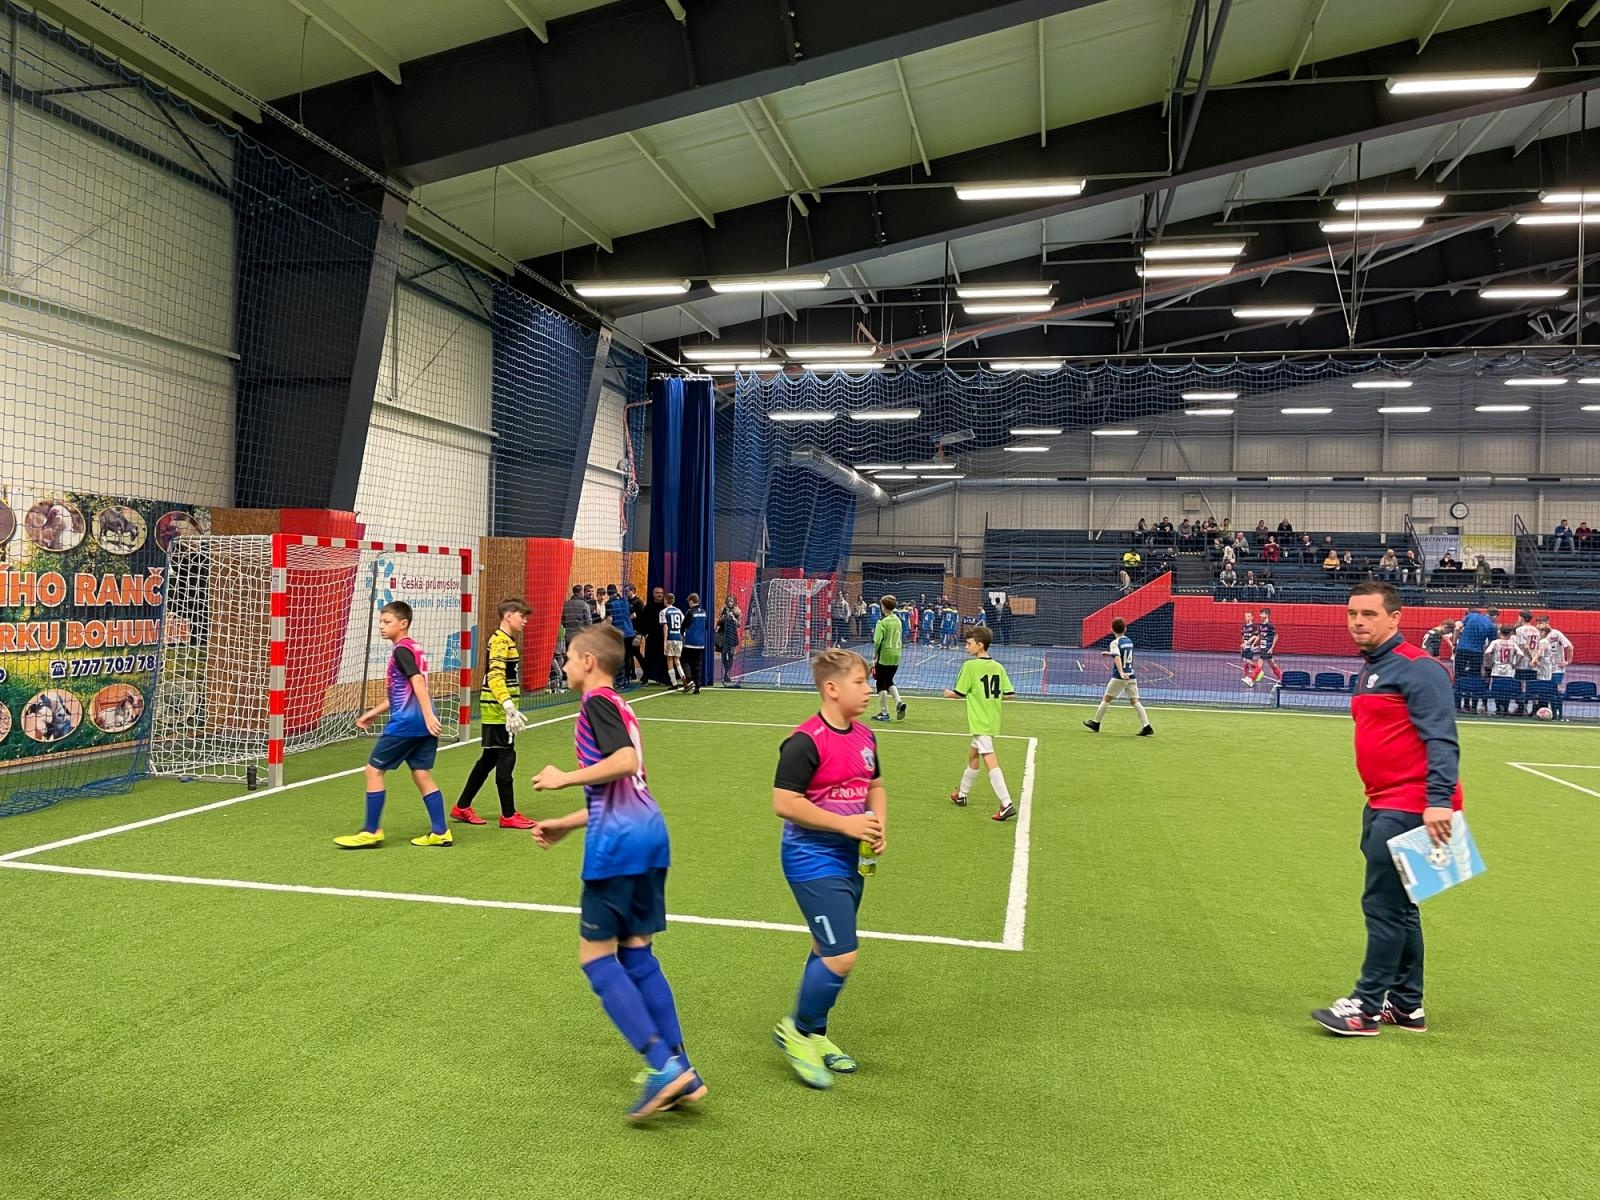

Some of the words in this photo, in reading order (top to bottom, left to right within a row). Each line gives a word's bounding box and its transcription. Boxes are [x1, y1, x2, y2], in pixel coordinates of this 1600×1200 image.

[74, 567, 165, 607] RANČ
[401, 574, 424, 590] Česká
[425, 577, 462, 592] průmyslov
[670, 614, 681, 629] 19
[70, 658, 102, 677] 777
[104, 655, 134, 674] 707
[1123, 649, 1133, 668] 14
[980, 674, 1001, 699] 14
[815, 915, 836, 945] 7
